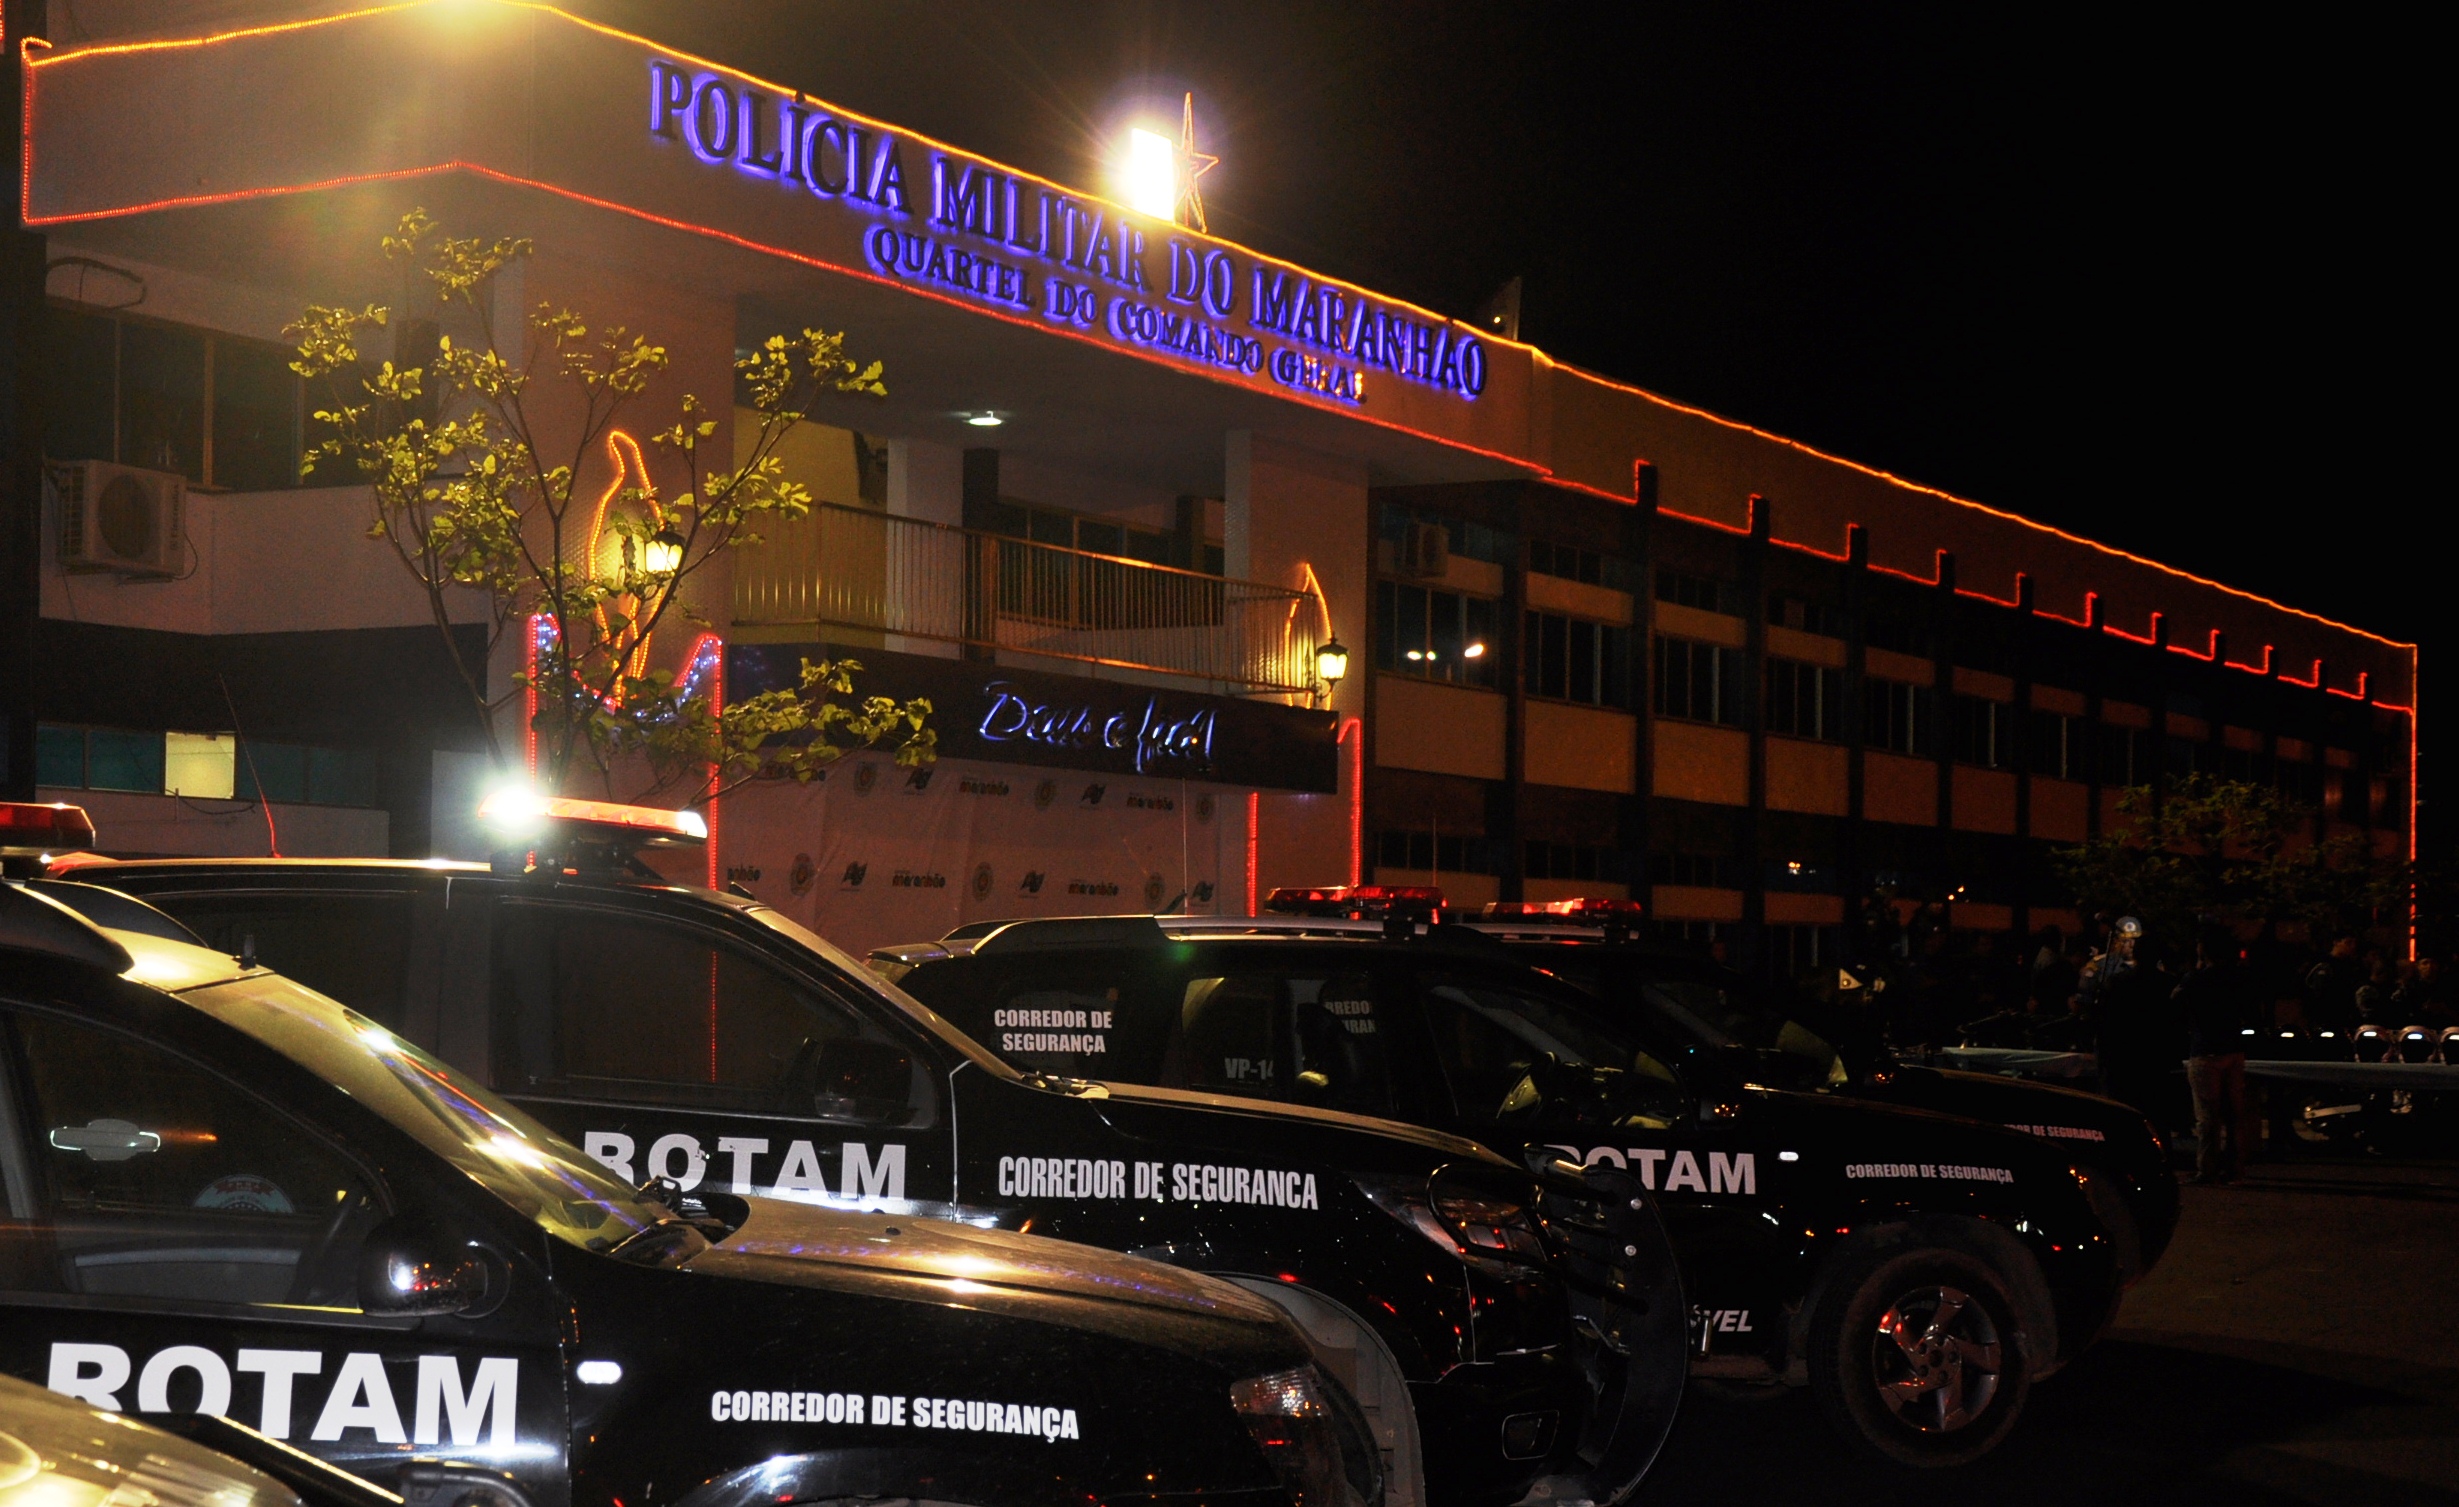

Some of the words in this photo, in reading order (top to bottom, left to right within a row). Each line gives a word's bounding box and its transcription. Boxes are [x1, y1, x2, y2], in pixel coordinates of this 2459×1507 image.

[935, 156, 1152, 295] MILITAR
[1168, 237, 1236, 317] DO
[868, 227, 1035, 308] QUARTEL
[1048, 280, 1097, 325] DO
[1112, 299, 1263, 373] COMANDO
[994, 1009, 1087, 1028] CORREDOR
[1090, 1010, 1113, 1029] DE
[1002, 1033, 1106, 1056] SEGURANÇA
[2031, 1125, 2047, 1137] DE
[584, 1130, 907, 1201] ROTAM
[999, 1156, 1125, 1198] CORREDOR
[1134, 1160, 1164, 1200] DE
[1845, 1163, 1918, 1179] CORREDOR
[1919, 1164, 1938, 1179] DE
[1938, 1165, 2015, 1184] SEGURANÇA
[47, 1342, 519, 1447] ROTAM
[711, 1391, 864, 1424] CORREDOR
[871, 1395, 907, 1427] DE
[913, 1397, 1080, 1443] SEGURANÇA
